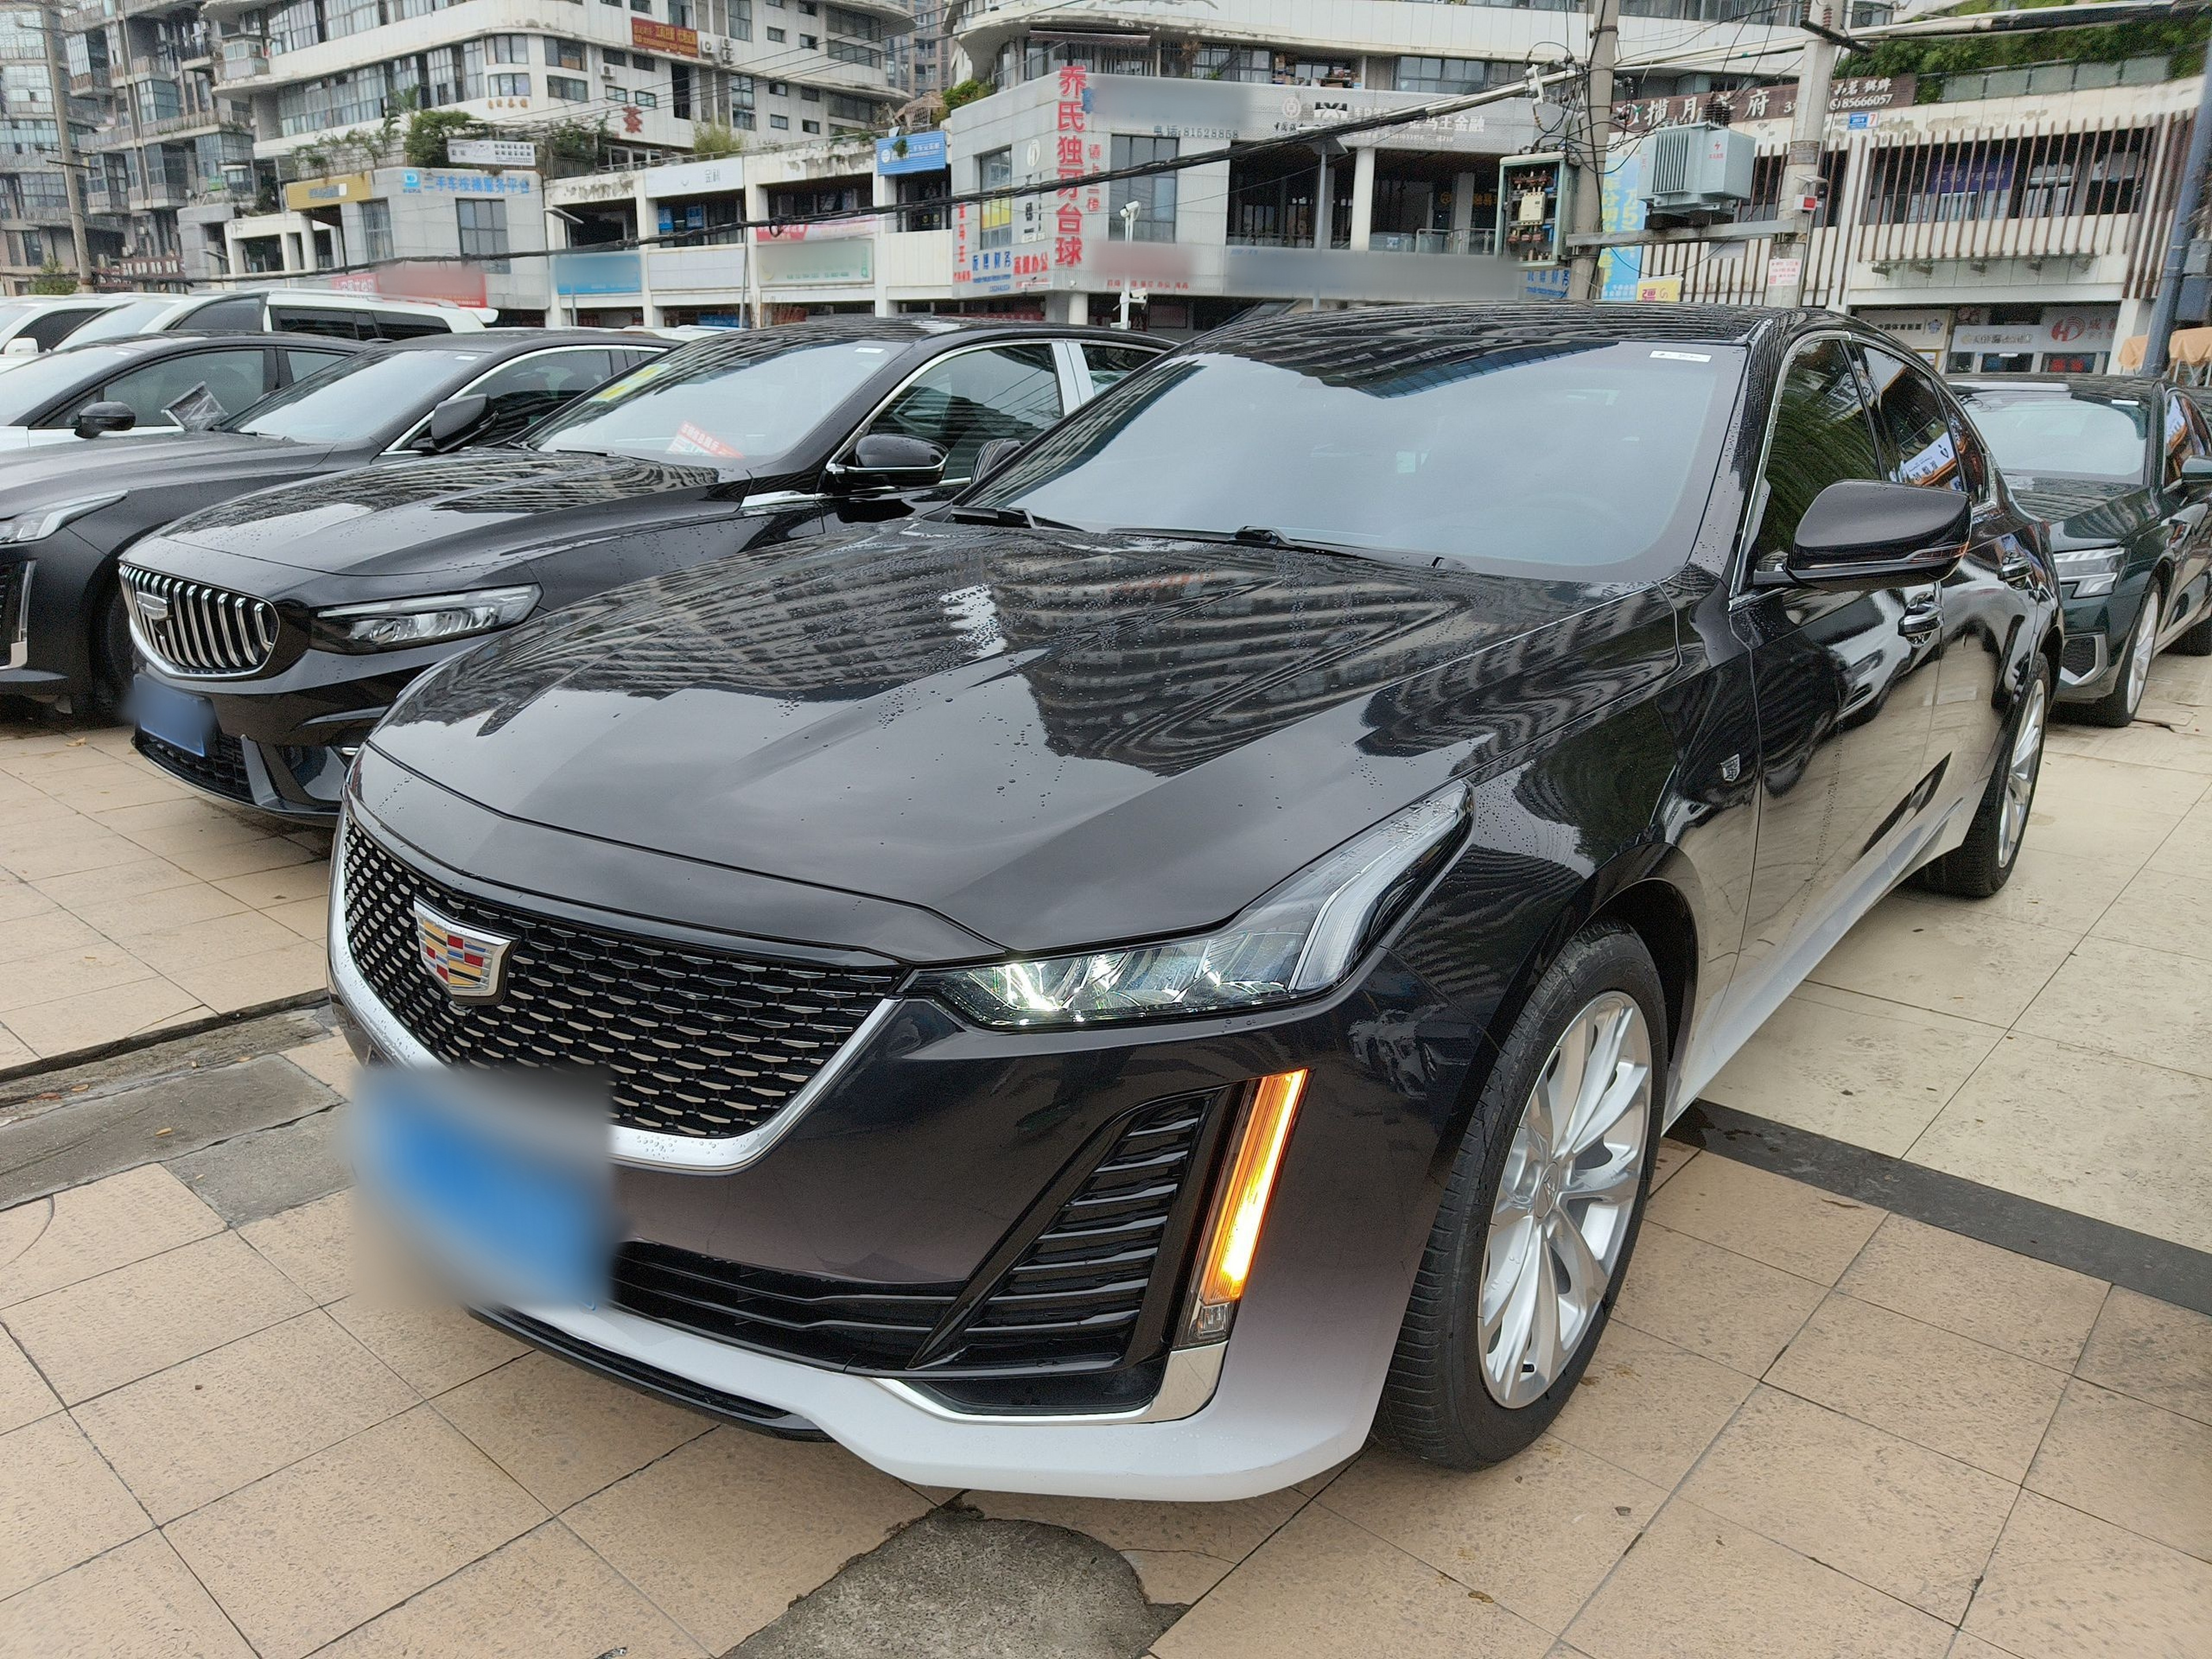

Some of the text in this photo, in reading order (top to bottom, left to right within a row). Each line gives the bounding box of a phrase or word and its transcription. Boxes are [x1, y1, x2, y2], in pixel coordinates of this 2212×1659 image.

[1841, 93, 1894, 108] 85666057
[1869, 113, 1876, 125] 7
[1055, 65, 1087, 268] 乔氏独牙台球
